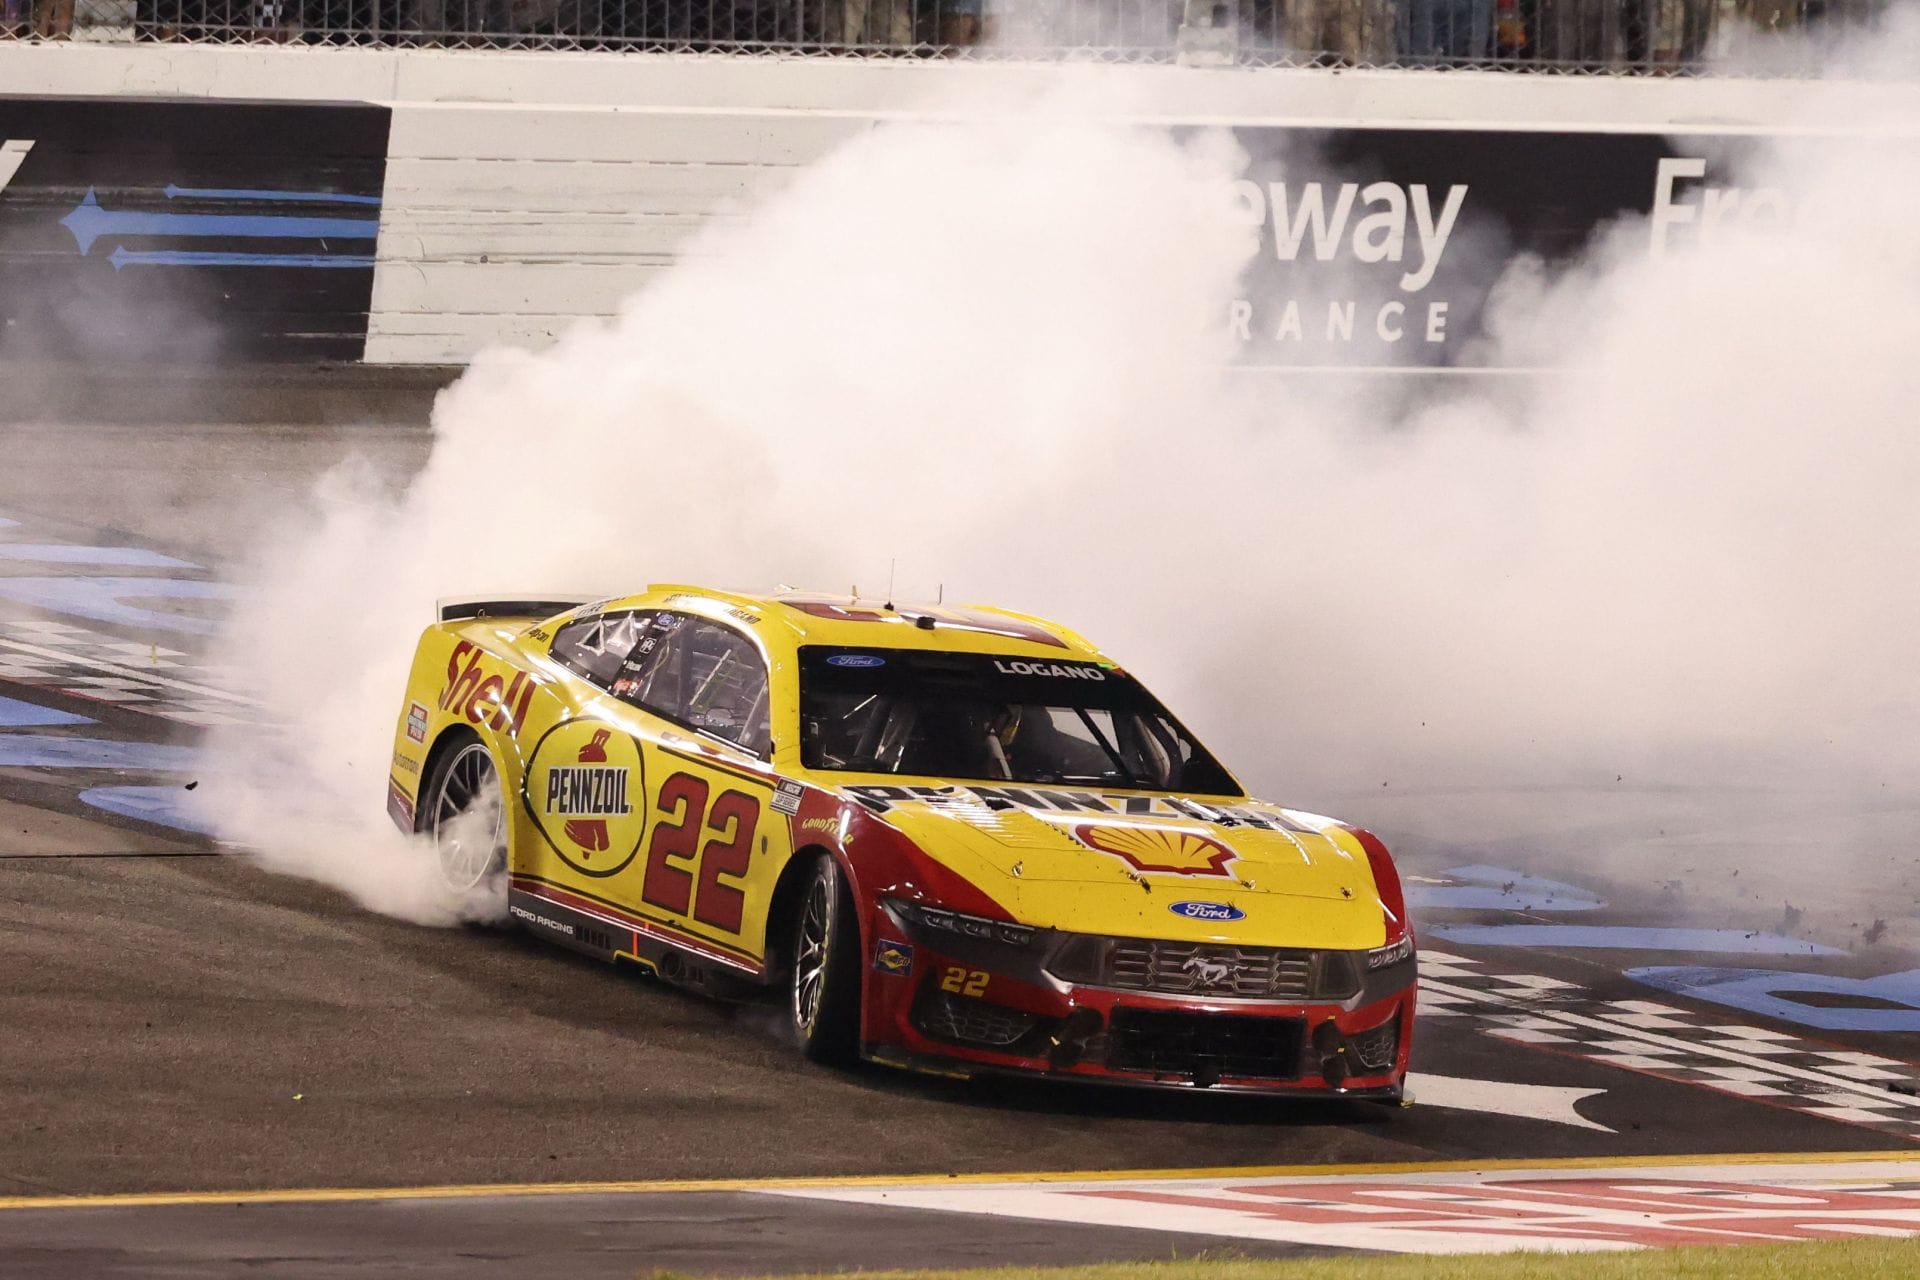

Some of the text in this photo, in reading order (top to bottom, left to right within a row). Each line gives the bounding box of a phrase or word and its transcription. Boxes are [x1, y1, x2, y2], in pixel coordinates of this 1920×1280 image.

[1231, 179, 1469, 292] eway
[1230, 300, 1449, 342] RANCE
[993, 660, 1105, 680] LOGANO
[438, 640, 537, 738] Shell
[546, 768, 630, 814] PENNZOIL
[802, 817, 854, 845] GOODYER
[642, 771, 760, 936] 22
[510, 905, 574, 935] FORD RACING
[1185, 903, 1231, 919] Ford
[941, 966, 991, 998] 22
